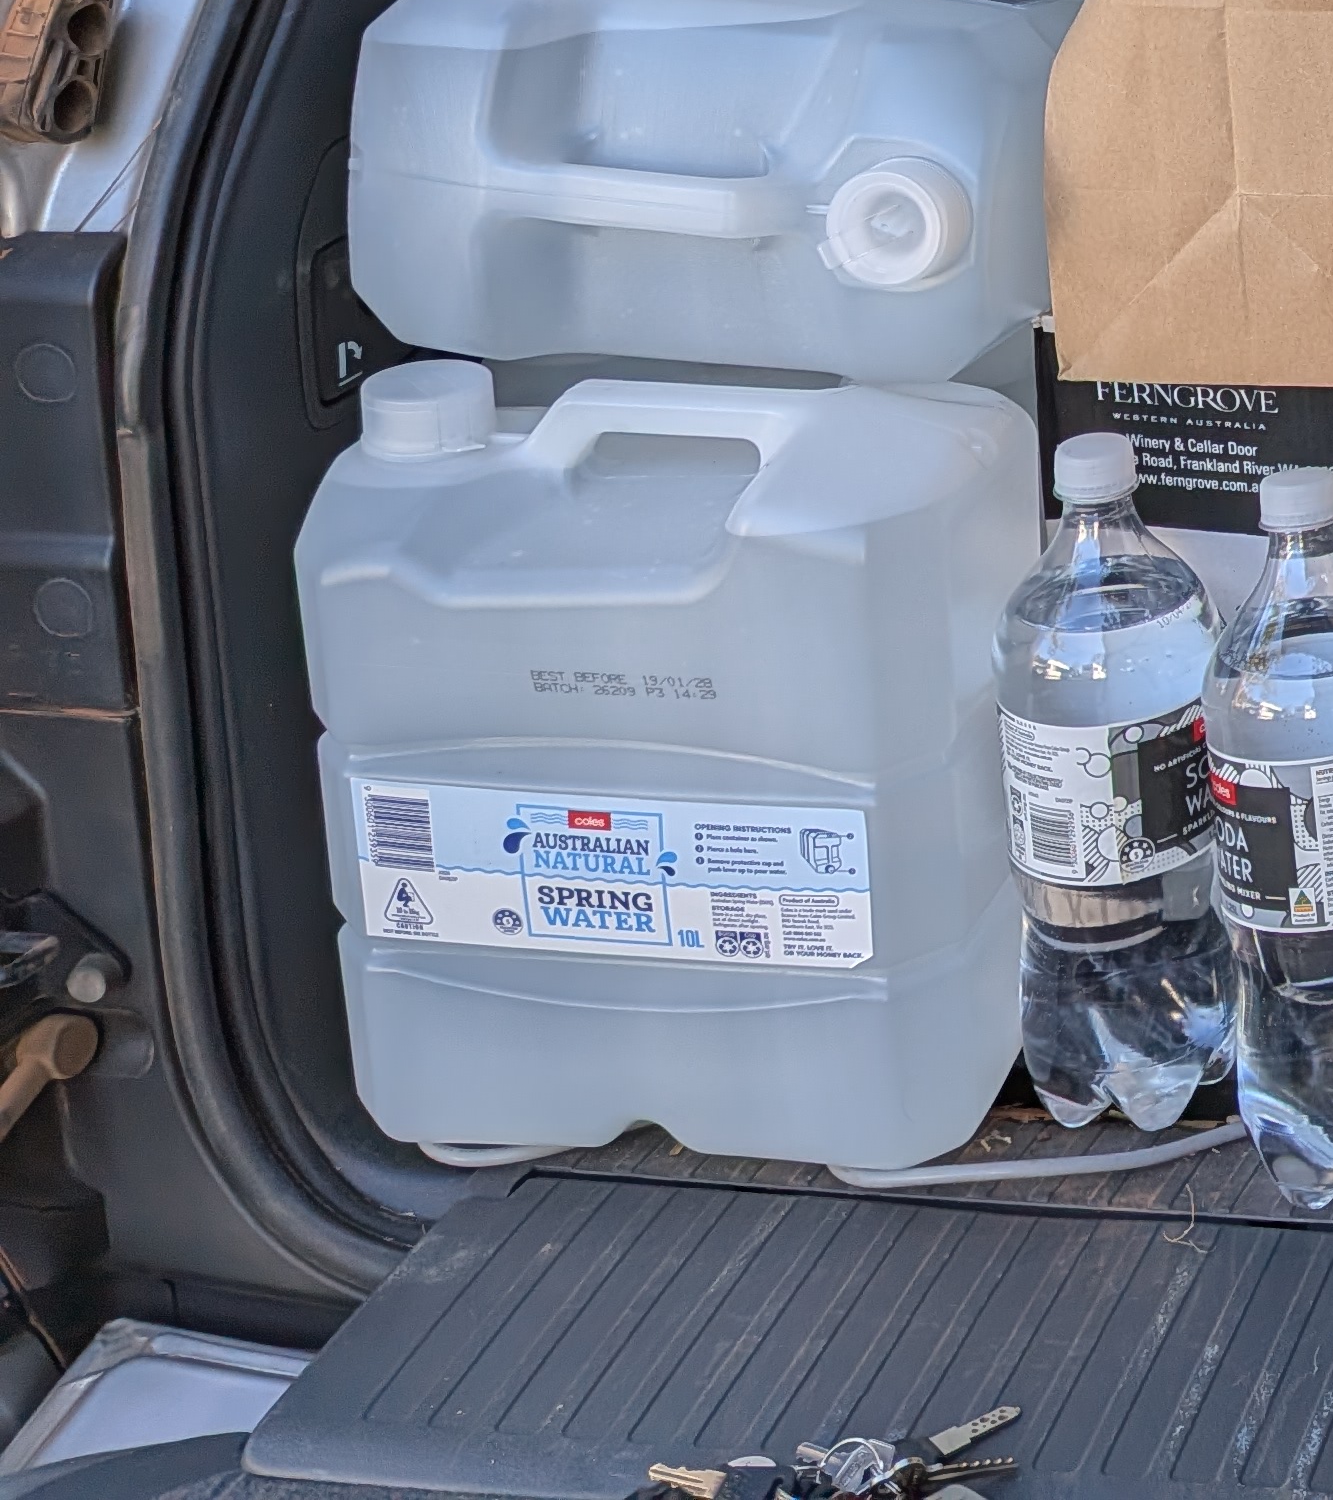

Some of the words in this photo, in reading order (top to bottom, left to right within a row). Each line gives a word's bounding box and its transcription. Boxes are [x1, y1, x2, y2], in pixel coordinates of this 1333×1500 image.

[1096, 381, 1279, 414] FERNGROVE
[1112, 411, 1178, 424] WESTERN
[1186, 418, 1267, 431] AUSTRALIA
[1126, 433, 1170, 452] Winery
[1174, 437, 1185, 451] &
[1187, 438, 1225, 455] Cellar
[1228, 441, 1258, 457] Door
[1142, 454, 1177, 470] Road,
[1180, 456, 1240, 474] Frankland
[1243, 461, 1277, 476] River
[1136, 473, 1261, 494] ww.ferngrove.com.a
[530, 670, 564, 682] BEST
[574, 671, 627, 686] BEFORE
[1153, 763, 1167, 773] NO
[574, 816, 605, 828] coles
[694, 823, 731, 832] OPENING
[733, 824, 792, 834] INSTRUCTIONS
[532, 832, 649, 856] AUSTRALIAN
[1215, 816, 1250, 852] ODA
[533, 849, 650, 876] NATURAL
[1219, 850, 1253, 884] ATER
[537, 885, 653, 912] SPRING
[1237, 890, 1262, 902] MIXER
[540, 906, 656, 933] WATER
[677, 929, 705, 948] 10L
